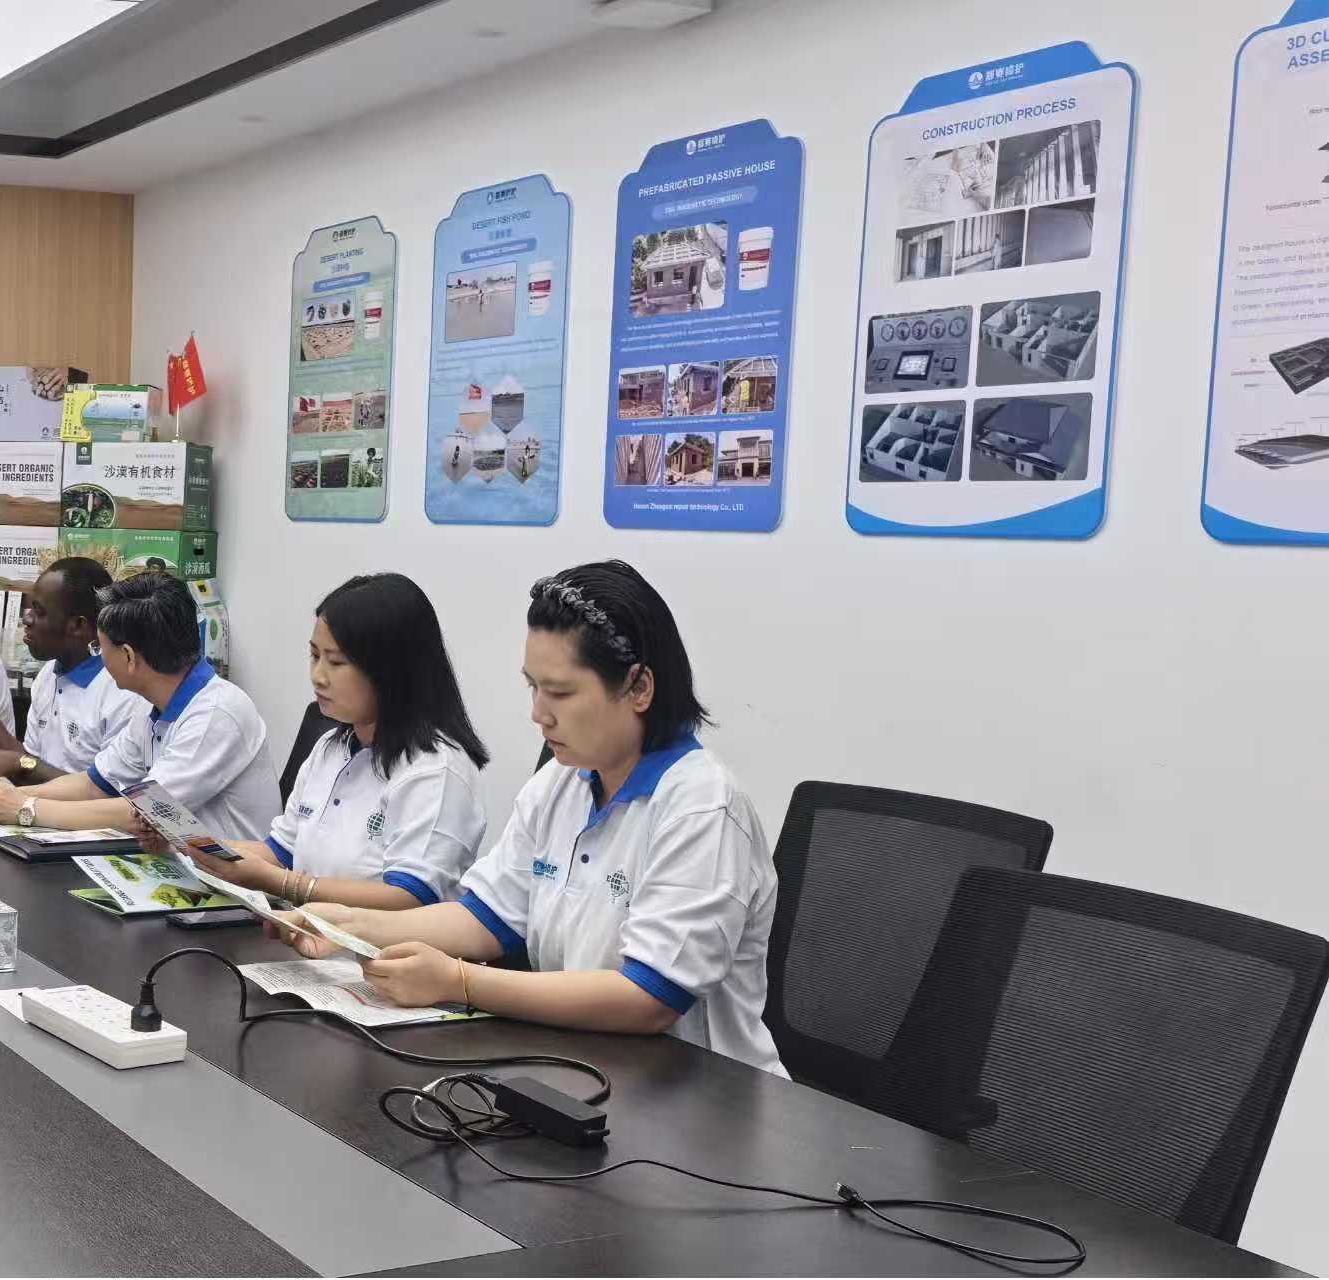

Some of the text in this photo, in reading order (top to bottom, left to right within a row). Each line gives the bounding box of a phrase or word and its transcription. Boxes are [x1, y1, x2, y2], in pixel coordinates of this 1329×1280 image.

[1287, 35, 1306, 50] 3D
[923, 97, 1076, 140] CONSTRUCTION PROCESS
[639, 160, 776, 198] PREFABRICATED PASSIVE HOUSE
[19, 463, 54, 473] ORGANIC
[104, 464, 176, 479] 沙漠有机食材
[2, 473, 54, 482] INGREDIENTS
